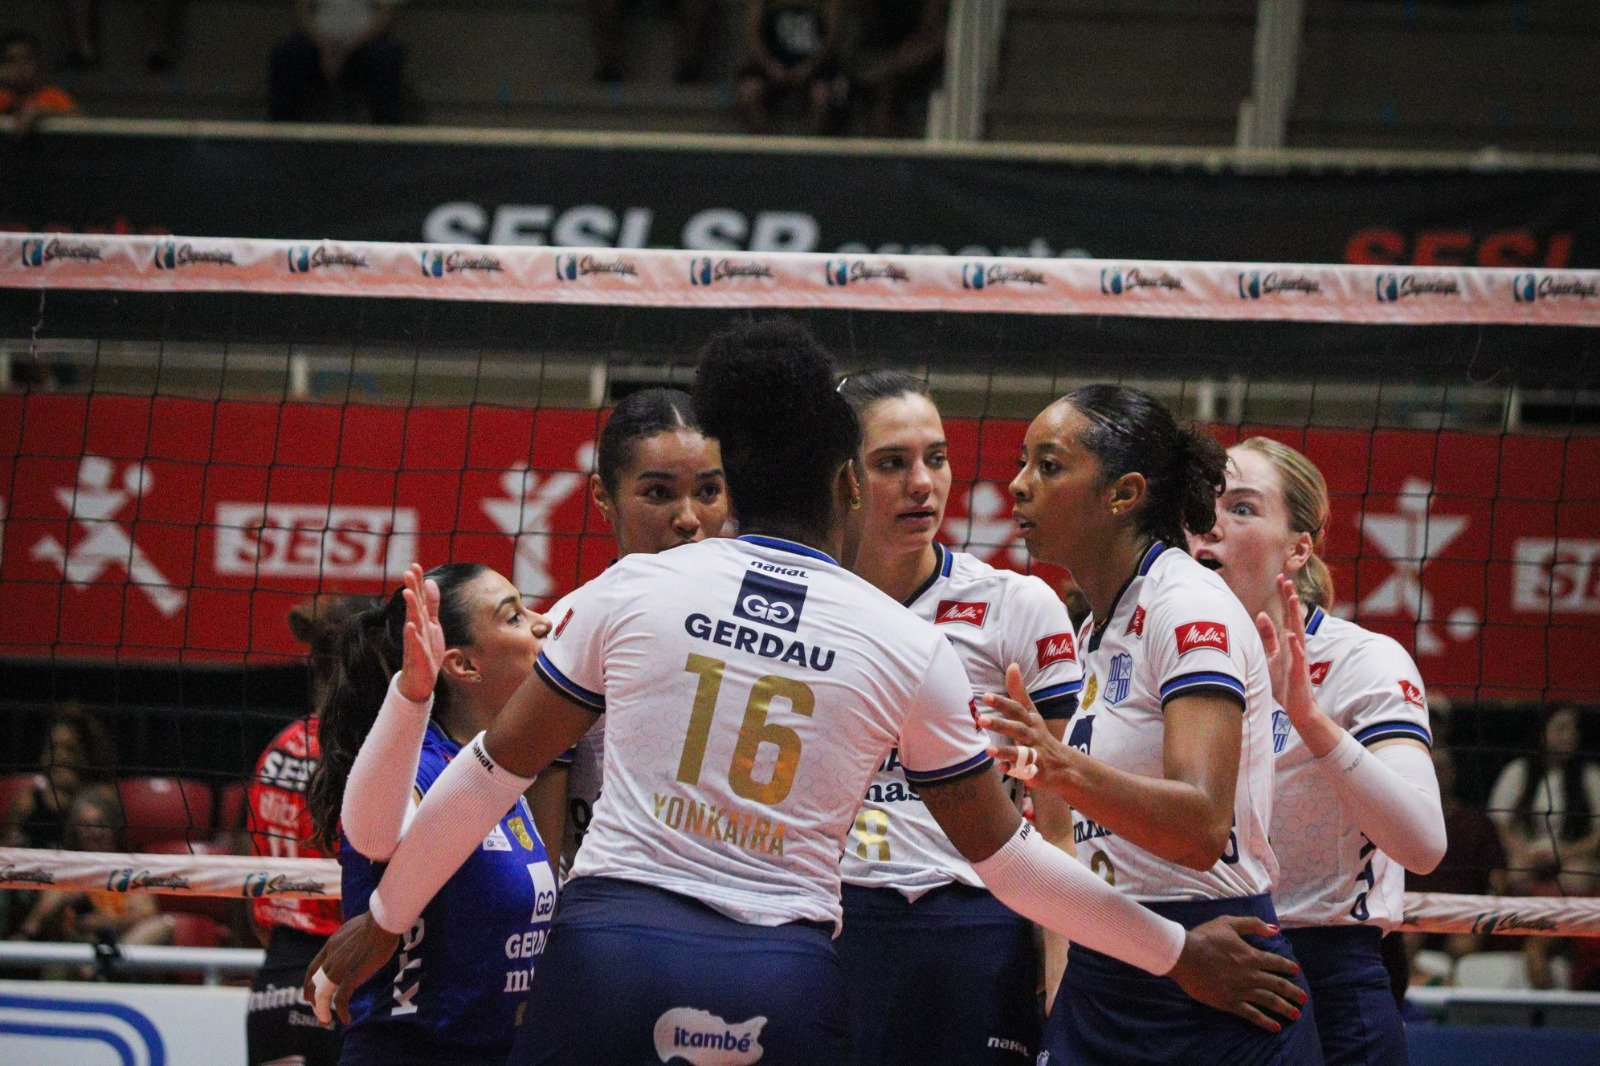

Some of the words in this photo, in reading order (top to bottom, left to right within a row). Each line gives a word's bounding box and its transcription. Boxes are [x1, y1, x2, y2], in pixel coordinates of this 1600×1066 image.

[235, 515, 393, 567] SESI
[684, 612, 836, 672] GERDAU
[1182, 624, 1223, 645] Melitta
[675, 652, 815, 806] 16
[865, 782, 924, 803] nas
[652, 792, 785, 857] YONKAIRA
[674, 1026, 752, 1053] itambé
